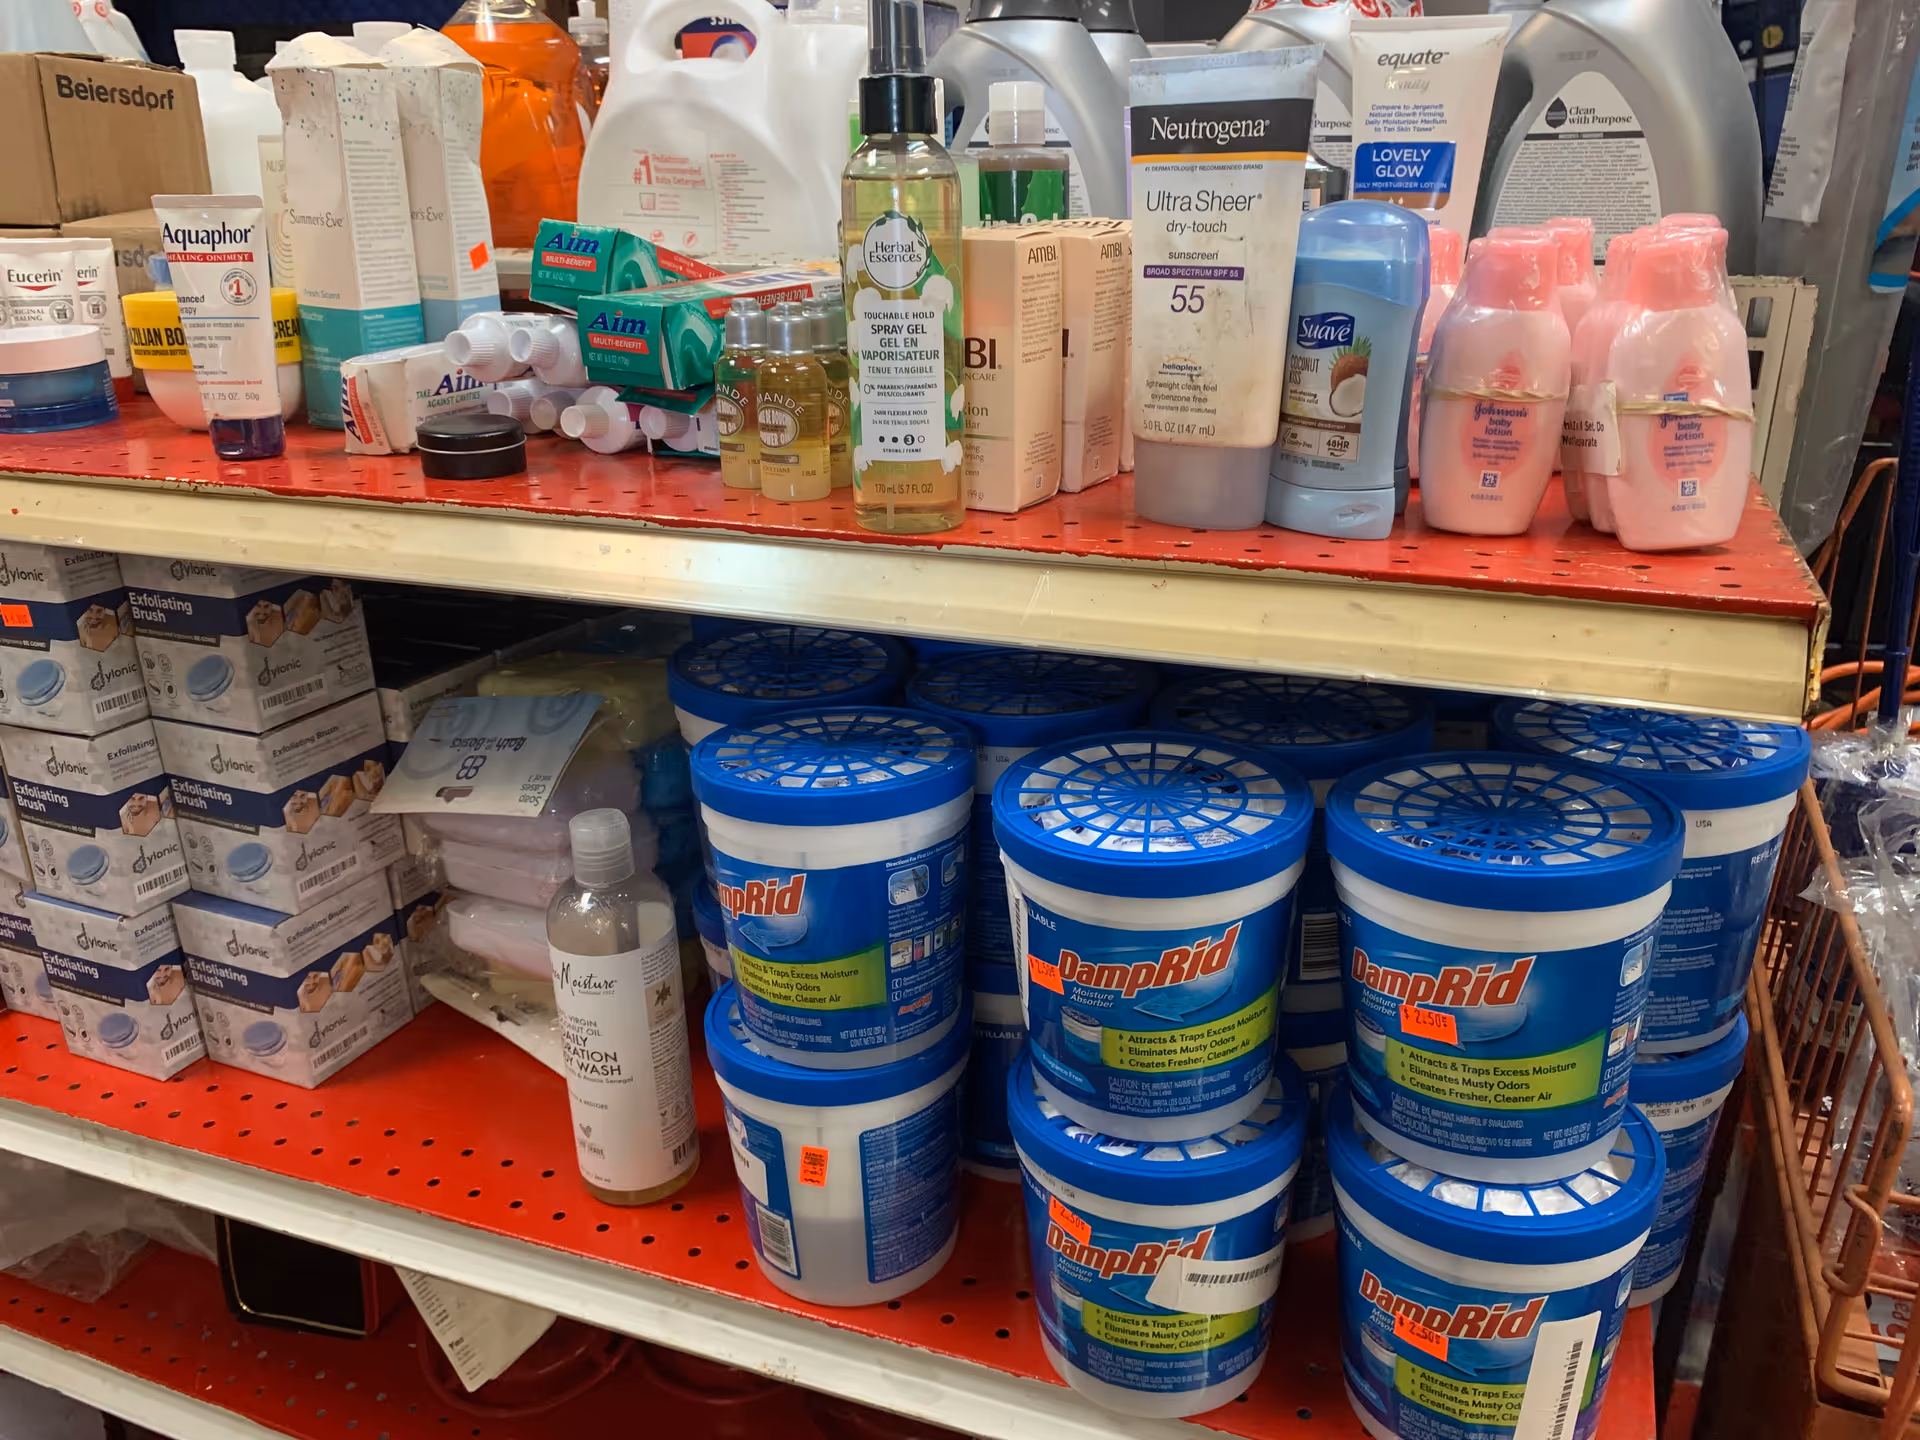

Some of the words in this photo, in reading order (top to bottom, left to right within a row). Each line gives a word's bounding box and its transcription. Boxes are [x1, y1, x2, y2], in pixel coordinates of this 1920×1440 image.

[1377, 49, 1443, 70] equate
[56, 73, 174, 111] Beiersdorf
[1418, 111, 1444, 119] Firming
[1569, 106, 1596, 115] Clean
[1365, 119, 1381, 127] Daily
[1568, 115, 1590, 125] with
[1591, 115, 1632, 126] Purpose
[1150, 117, 1265, 145] Neutrogena
[1372, 149, 1431, 162] LOVELY
[1375, 165, 1424, 178] GLOW
[1147, 190, 1192, 212] Ultra
[1195, 190, 1256, 212] Sheer
[290, 208, 324, 227] Summer's
[325, 212, 344, 229] Eve
[425, 206, 444, 222] Eve
[1166, 220, 1228, 236] dry-touch
[162, 221, 252, 252] Aquaphor
[543, 231, 600, 254] Aim
[875, 241, 916, 253] Herbal
[1027, 245, 1058, 265] AMBI
[1100, 242, 1123, 260] AMBI
[167, 254, 203, 262] HEALING
[206, 253, 249, 262] OINTMENT
[546, 255, 593, 267] MULTI-BENEFIT
[869, 251, 922, 263] Essences
[1168, 250, 1219, 261] sunscreen
[7, 269, 62, 283] Eucerin
[1146, 267, 1170, 275] BROAD
[1171, 268, 1212, 277] SPECTRUM
[1213, 269, 1228, 277] SPF
[1170, 284, 1205, 314] 55
[586, 310, 648, 335] Aim
[864, 311, 910, 320] TOUCHABLE
[912, 311, 935, 319] HOLD
[870, 324, 904, 335] SPRAY
[906, 324, 927, 334] GEL
[1299, 317, 1352, 342] Suave
[593, 337, 643, 350] MULTI-BENEFIT
[879, 337, 900, 348] GEL
[903, 337, 918, 348] EN
[861, 349, 940, 361] VAPORISATEUR
[868, 366, 892, 374] TENUE
[894, 365, 934, 374] TANGIBLE
[1162, 362, 1198, 371] helioplex
[1290, 354, 1320, 374] COCONUT
[1180, 383, 1201, 391] clean
[1203, 384, 1218, 392] feel
[427, 396, 455, 409] AGAINST
[455, 391, 481, 404] CAVITIES
[1150, 393, 1191, 402] oxybenzone
[1192, 395, 1208, 403] free
[1164, 421, 1176, 433] OZ
[1177, 423, 1197, 434] (147
[1488, 417, 1513, 428] baby
[1677, 420, 1702, 431] baby
[1484, 426, 1513, 437] lotion
[1674, 430, 1704, 441] lotion
[1326, 439, 1350, 449] 48HR
[129, 592, 193, 615] Exfoliating
[132, 607, 167, 623] Brush
[107, 738, 155, 761] Exfoliating
[449, 736, 484, 752] Basics
[495, 736, 527, 752] Bath
[13, 781, 69, 807] Exfoliating
[171, 778, 233, 805] Exfoliating
[520, 783, 547, 795] Cases
[17, 795, 46, 813] Brush
[174, 792, 208, 810] Brush
[518, 793, 542, 808] Soap
[1695, 820, 1712, 828] USA
[42, 951, 99, 979] Exfoliating
[1057, 919, 1243, 998] DampRid
[46, 963, 77, 982] Brush
[188, 957, 249, 986] Exfoliating
[192, 970, 224, 989] Brush
[769, 965, 790, 979] Traps
[790, 970, 819, 980] Excess
[820, 968, 859, 979] Moisture
[1351, 946, 1538, 1007] DampRid
[771, 979, 794, 992] Musty
[795, 982, 821, 992] Odors
[795, 994, 827, 1003] Cleaner
[828, 994, 841, 1003] Air
[1070, 994, 1114, 1009] Absorber
[1072, 987, 1115, 1001] Moisture
[1362, 988, 1397, 1009] Moisture
[1361, 997, 1397, 1018] Absorber
[569, 1015, 598, 1029] VIRGIN
[1128, 1033, 1167, 1044] Attracts
[1179, 1031, 1205, 1045] Traps
[1206, 1022, 1236, 1038] Excess
[1236, 1006, 1269, 1027] Moisture
[586, 1029, 602, 1038] OIL
[1128, 1045, 1178, 1056] Eliminates
[1179, 1042, 1208, 1055] Musty
[1209, 1034, 1236, 1049] Odors
[1128, 1057, 1166, 1068] Creates
[1167, 1054, 1206, 1068] Fresher,
[1207, 1045, 1239, 1062] Cleaner
[1408, 1050, 1448, 1071] Attracts
[1449, 1061, 1459, 1071] &
[1461, 1064, 1491, 1078] Traps
[1493, 1066, 1531, 1077] Excess
[1532, 1060, 1577, 1076] Moisture
[577, 1060, 622, 1077] WASH
[1409, 1064, 1459, 1087] Eliminates
[1461, 1077, 1495, 1091] Musty
[1496, 1080, 1531, 1091] Odors
[1409, 1077, 1447, 1097] Creates
[1448, 1090, 1492, 1104] Fresher,
[1494, 1093, 1536, 1104] Cleaner
[1537, 1091, 1552, 1102] Air
[1056, 1263, 1094, 1284] Absorber
[1058, 1257, 1094, 1277] Moisture
[1104, 1311, 1141, 1327] Attracts
[1151, 1318, 1177, 1329] Traps
[1178, 1315, 1210, 1328] Excess
[1104, 1322, 1150, 1339] Eliminates
[1151, 1326, 1180, 1340] Musty
[1181, 1326, 1209, 1337] Odors
[1104, 1332, 1139, 1348] Creates
[1140, 1338, 1177, 1350] Fresher,
[1419, 1371, 1459, 1393] Attracts
[1472, 1386, 1500, 1399] Traps
[1419, 1382, 1470, 1407] Eliminates
[1471, 1398, 1503, 1412] Musty
[1419, 1394, 1457, 1416] Creates
[1458, 1408, 1499, 1422] Fresher,
